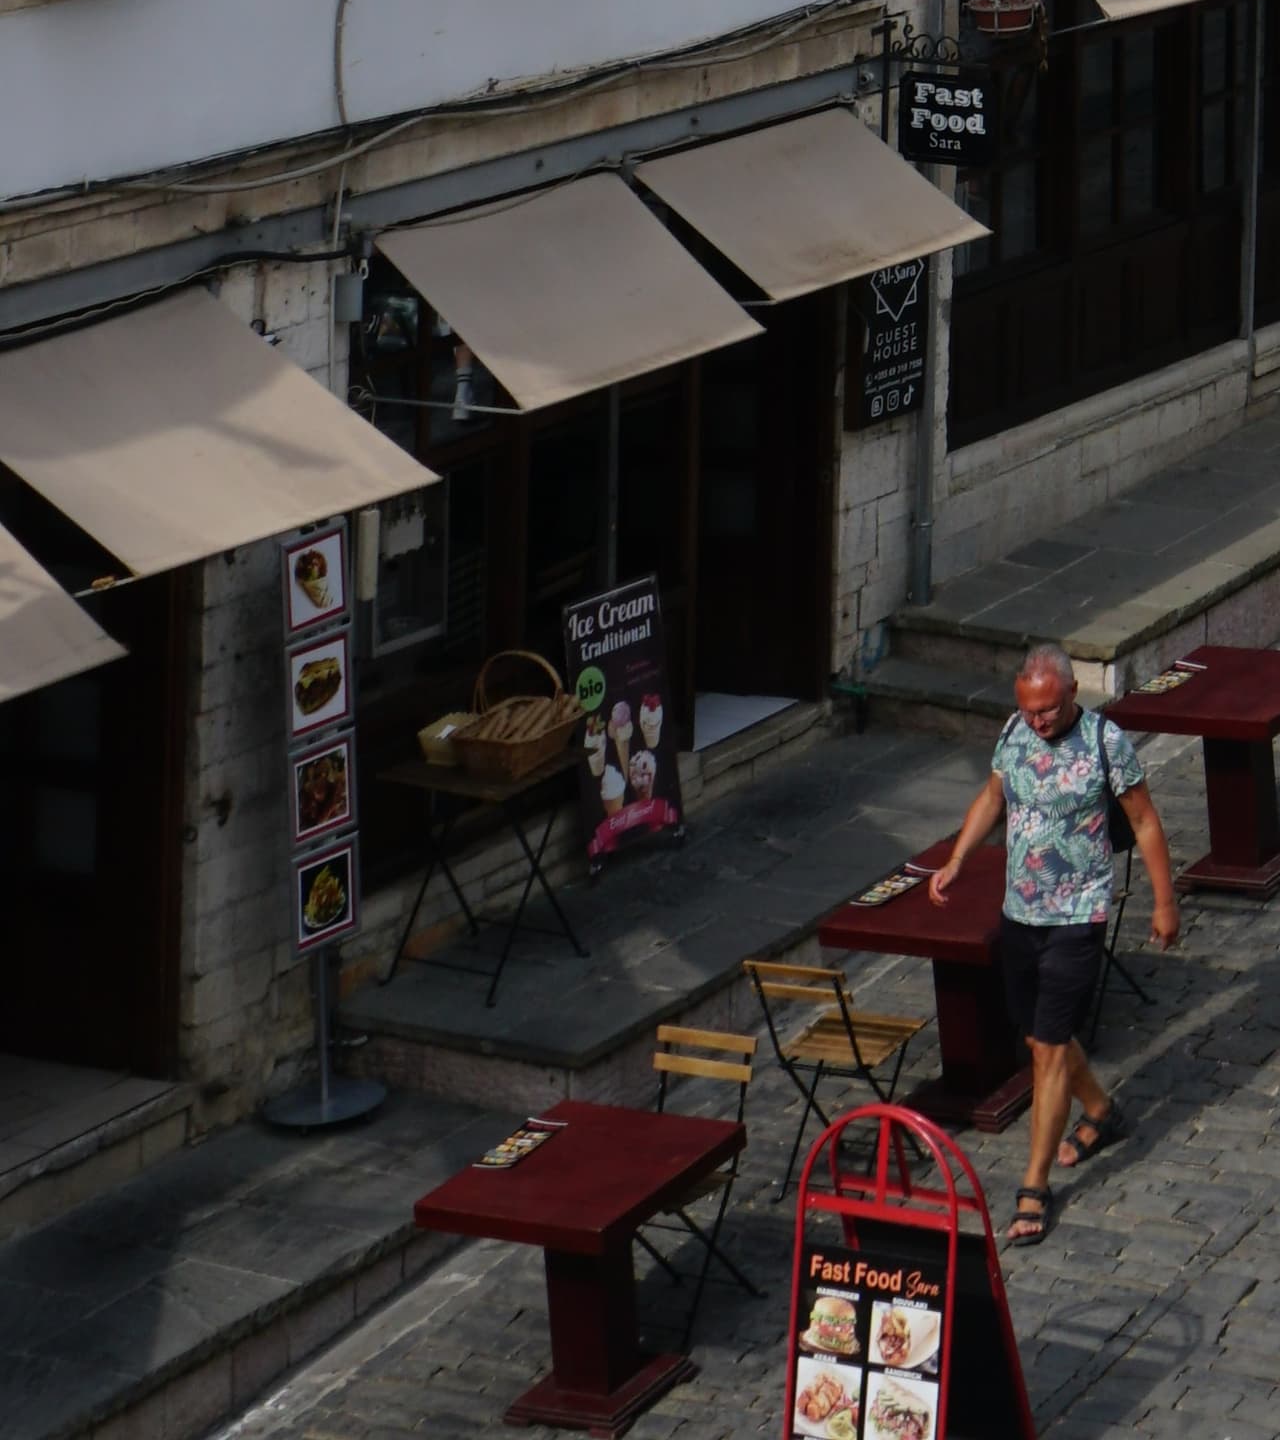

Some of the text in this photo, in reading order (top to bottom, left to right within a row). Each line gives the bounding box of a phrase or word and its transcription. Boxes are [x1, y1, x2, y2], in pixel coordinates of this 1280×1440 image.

[914, 82, 983, 108] Fast
[911, 108, 986, 135] Food
[929, 132, 961, 150] Sara
[875, 322, 917, 346] GUEST
[873, 336, 918, 363] HOUSE
[568, 594, 655, 642] Ice Cream
[579, 679, 603, 700] bio
[810, 1255, 850, 1284] Fast
[854, 1262, 903, 1292] Food
